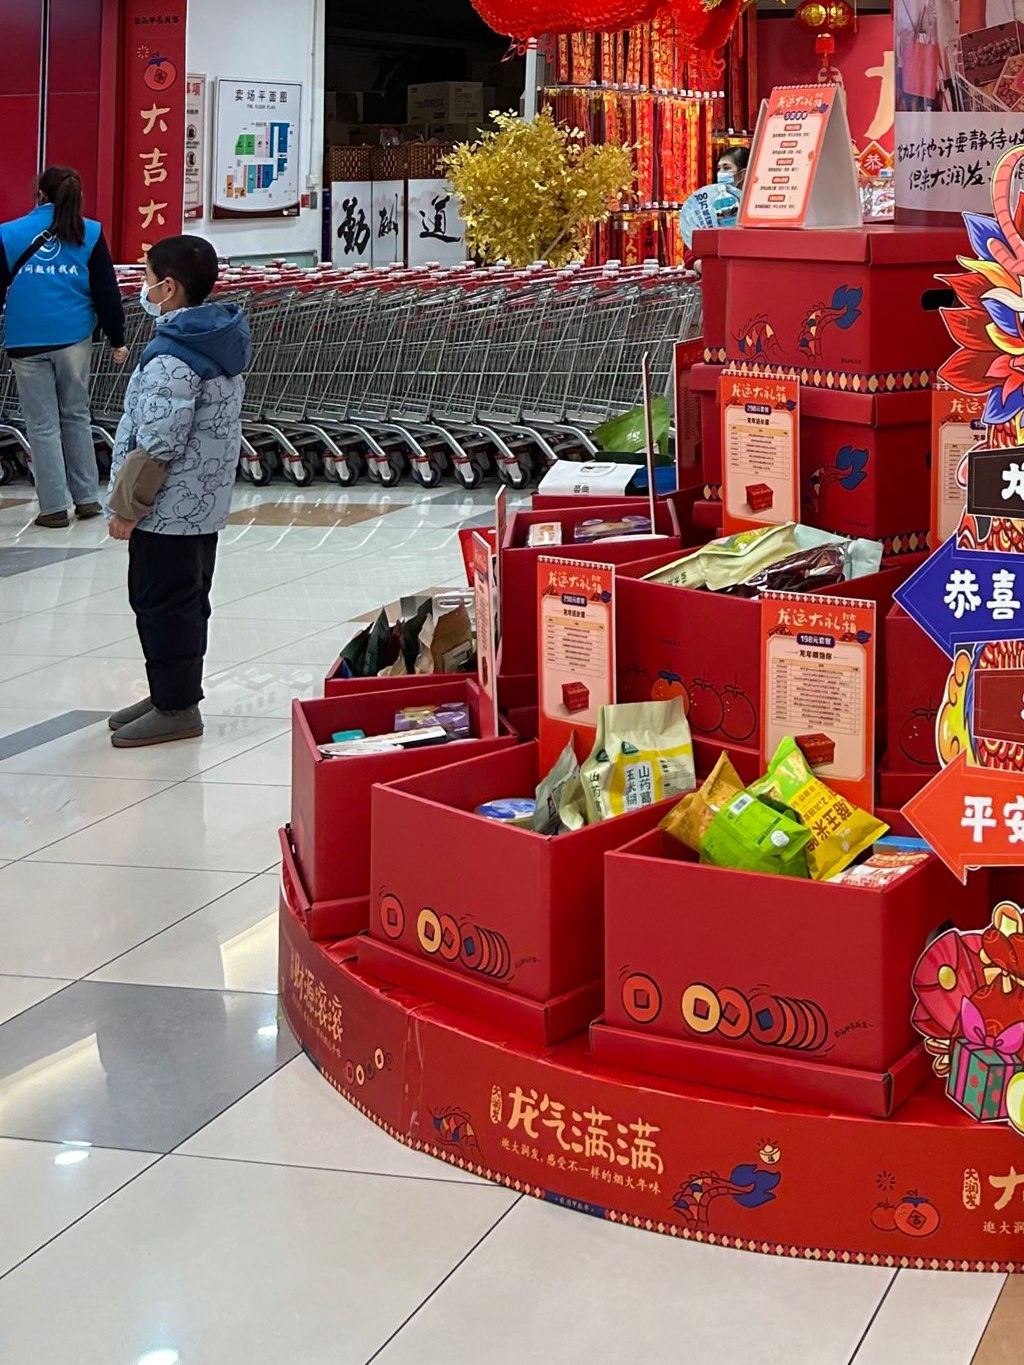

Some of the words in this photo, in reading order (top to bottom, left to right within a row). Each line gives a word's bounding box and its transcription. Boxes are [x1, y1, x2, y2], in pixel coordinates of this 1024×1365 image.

[234, 88, 288, 104] 卖场平面图
[864, 153, 884, 170] 恭
[419, 195, 461, 243] 道
[732, 383, 787, 403] 龙运大礼箱
[548, 570, 603, 594] 龙运大礼箱
[778, 608, 857, 633] 龙运大礼箱
[507, 1086, 664, 1175] 龙气满满
[963, 1167, 981, 1210] 大润发
